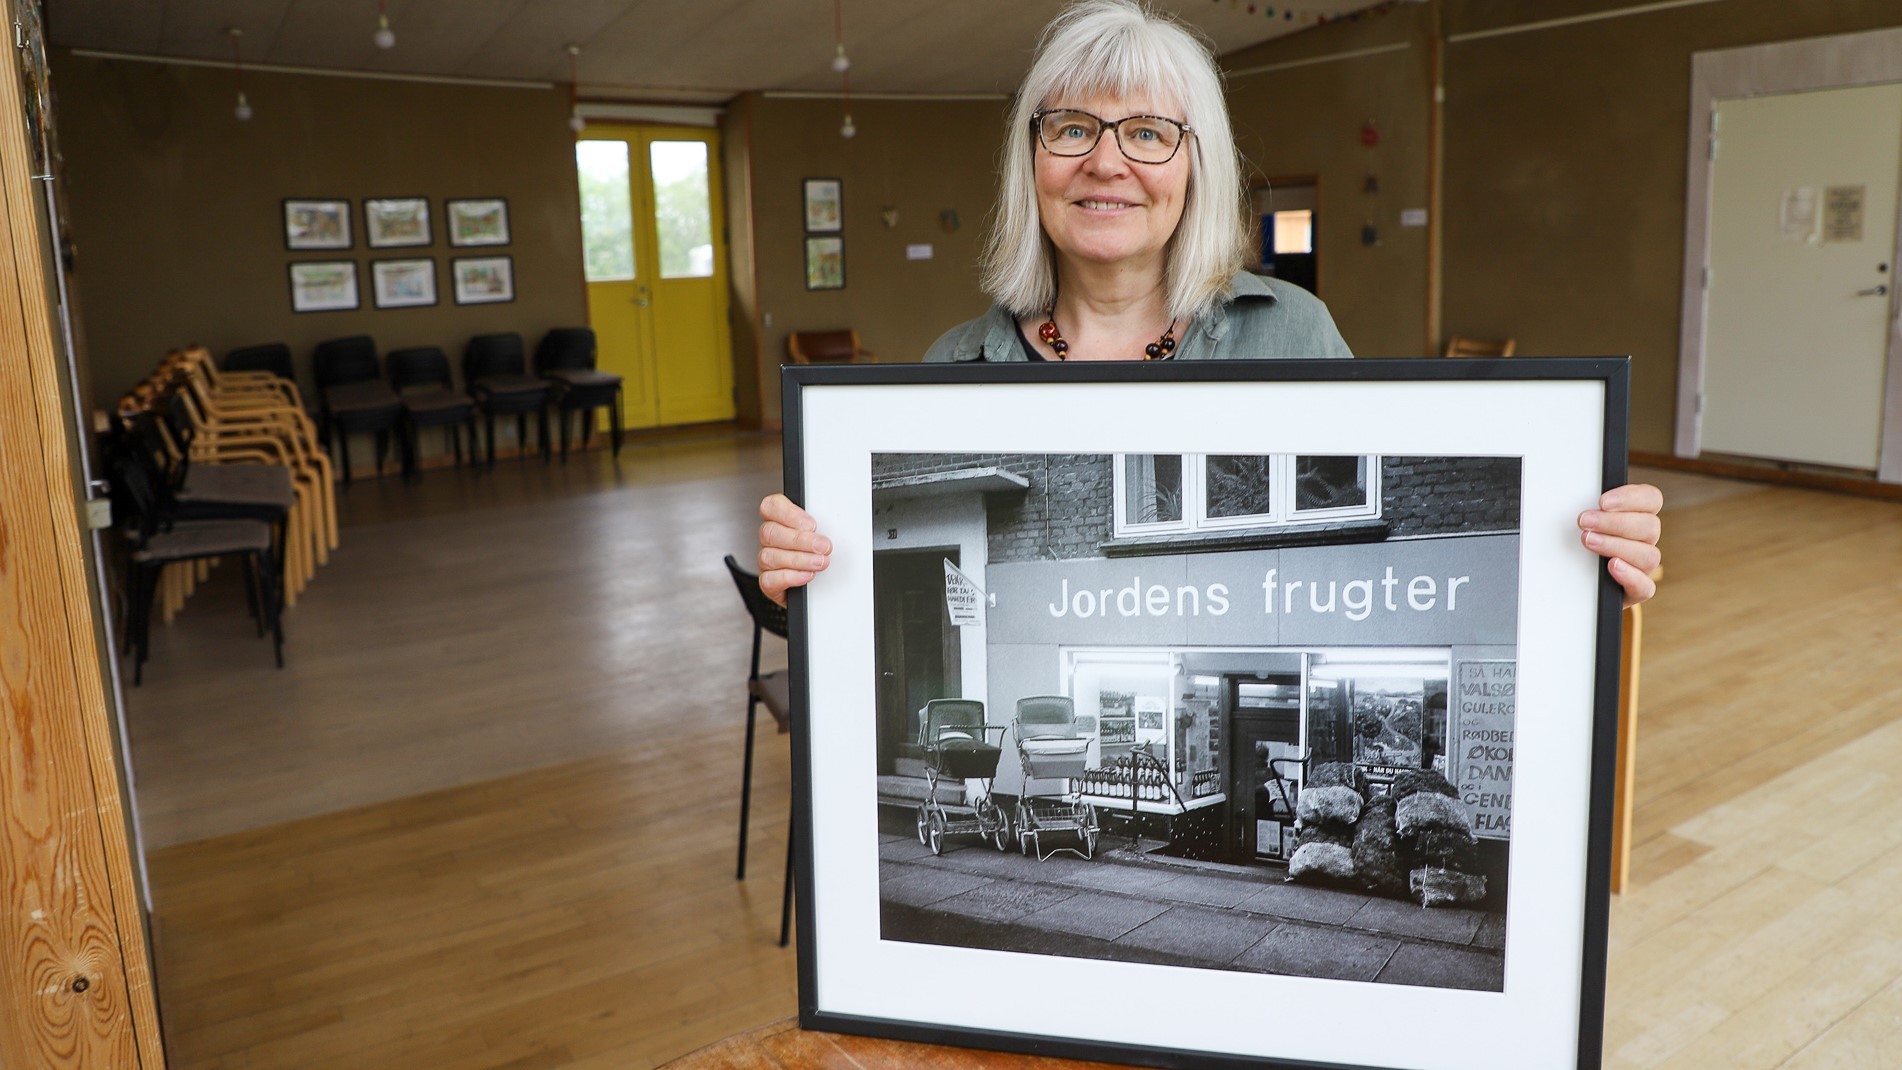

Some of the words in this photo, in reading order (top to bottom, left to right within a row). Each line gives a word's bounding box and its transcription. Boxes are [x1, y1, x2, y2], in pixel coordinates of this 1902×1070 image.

[1049, 576, 1230, 618] Jordens
[1262, 566, 1470, 621] frugter
[1493, 668, 1517, 678] HA
[1468, 765, 1513, 781] DAN
